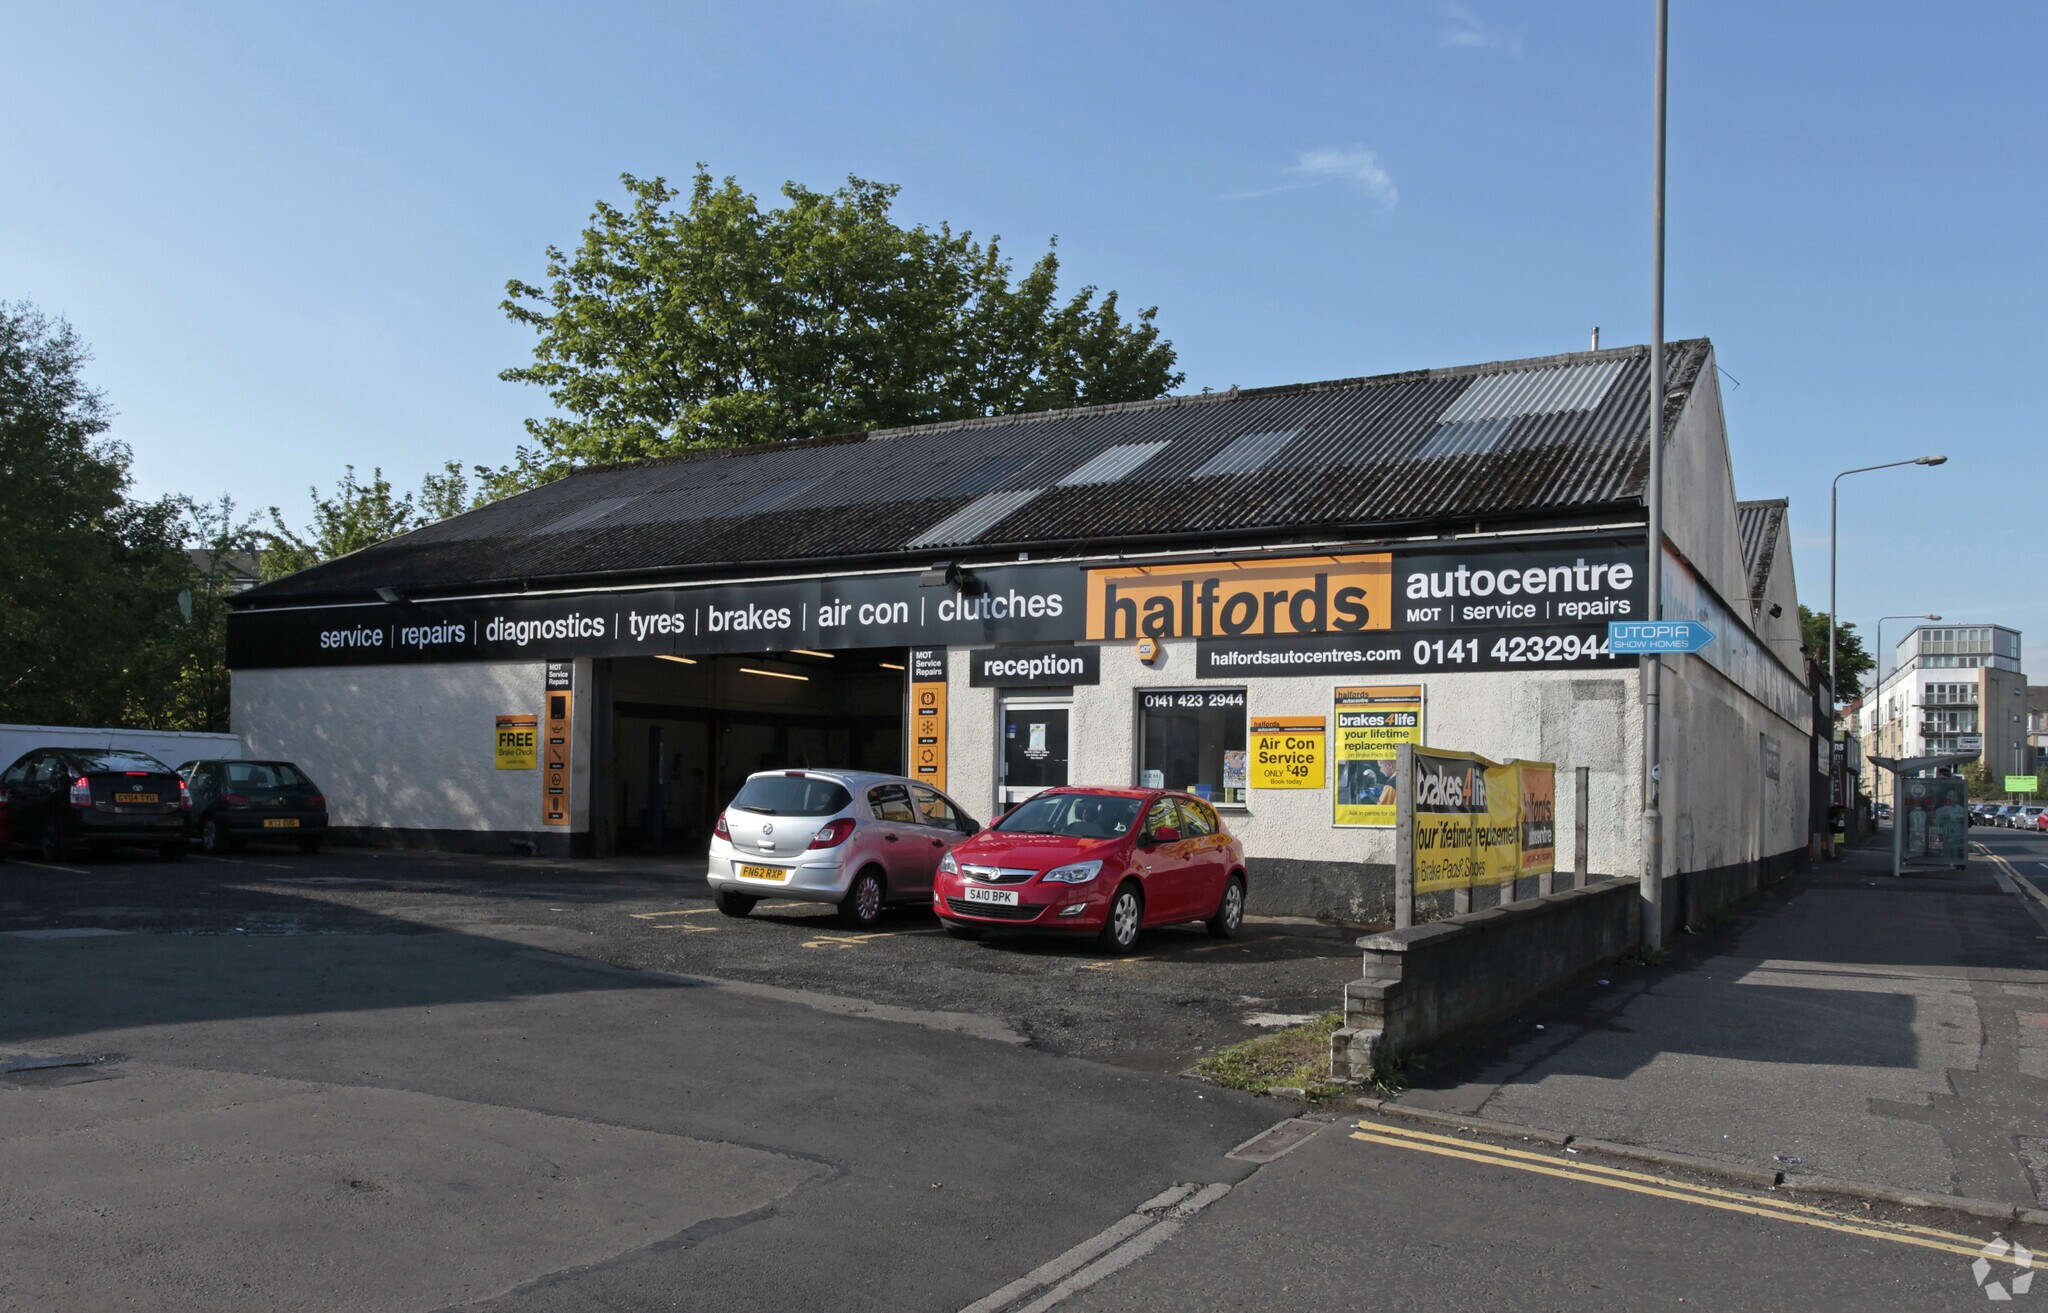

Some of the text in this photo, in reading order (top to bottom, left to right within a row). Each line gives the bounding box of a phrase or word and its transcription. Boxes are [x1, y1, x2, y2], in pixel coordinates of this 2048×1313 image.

[1406, 558, 1634, 599] autocentre
[1104, 573, 1370, 639] halfords
[1406, 596, 1631, 623] MOT service repairs
[320, 589, 1063, 650] service repairs diagnostics tyres brakes air con clutches
[1614, 625, 1690, 639] UTOPIA
[1614, 639, 1689, 649] SHOW HOMES
[916, 651, 932, 659] MOT
[1210, 647, 1401, 667] halfordsautocentres.com
[1412, 638, 1479, 666] 0141
[916, 660, 942, 668] Service
[984, 654, 1084, 680] reception
[916, 668, 942, 676] Repairs
[1145, 693, 1243, 707] 0141 423 2944
[1338, 691, 1369, 699] halfords
[1340, 713, 1415, 726] brakes4life
[499, 732, 533, 747] FREE
[1344, 728, 1409, 740] your lifetime
[1259, 737, 1315, 750] Air Con
[1344, 741, 1397, 752] replaceme
[498, 748, 533, 756] Brake Check
[1259, 751, 1314, 764] Service
[1286, 764, 1309, 777] £49
[742, 866, 783, 879] FN62 RXP
[970, 888, 1011, 903] SA10 BPK
